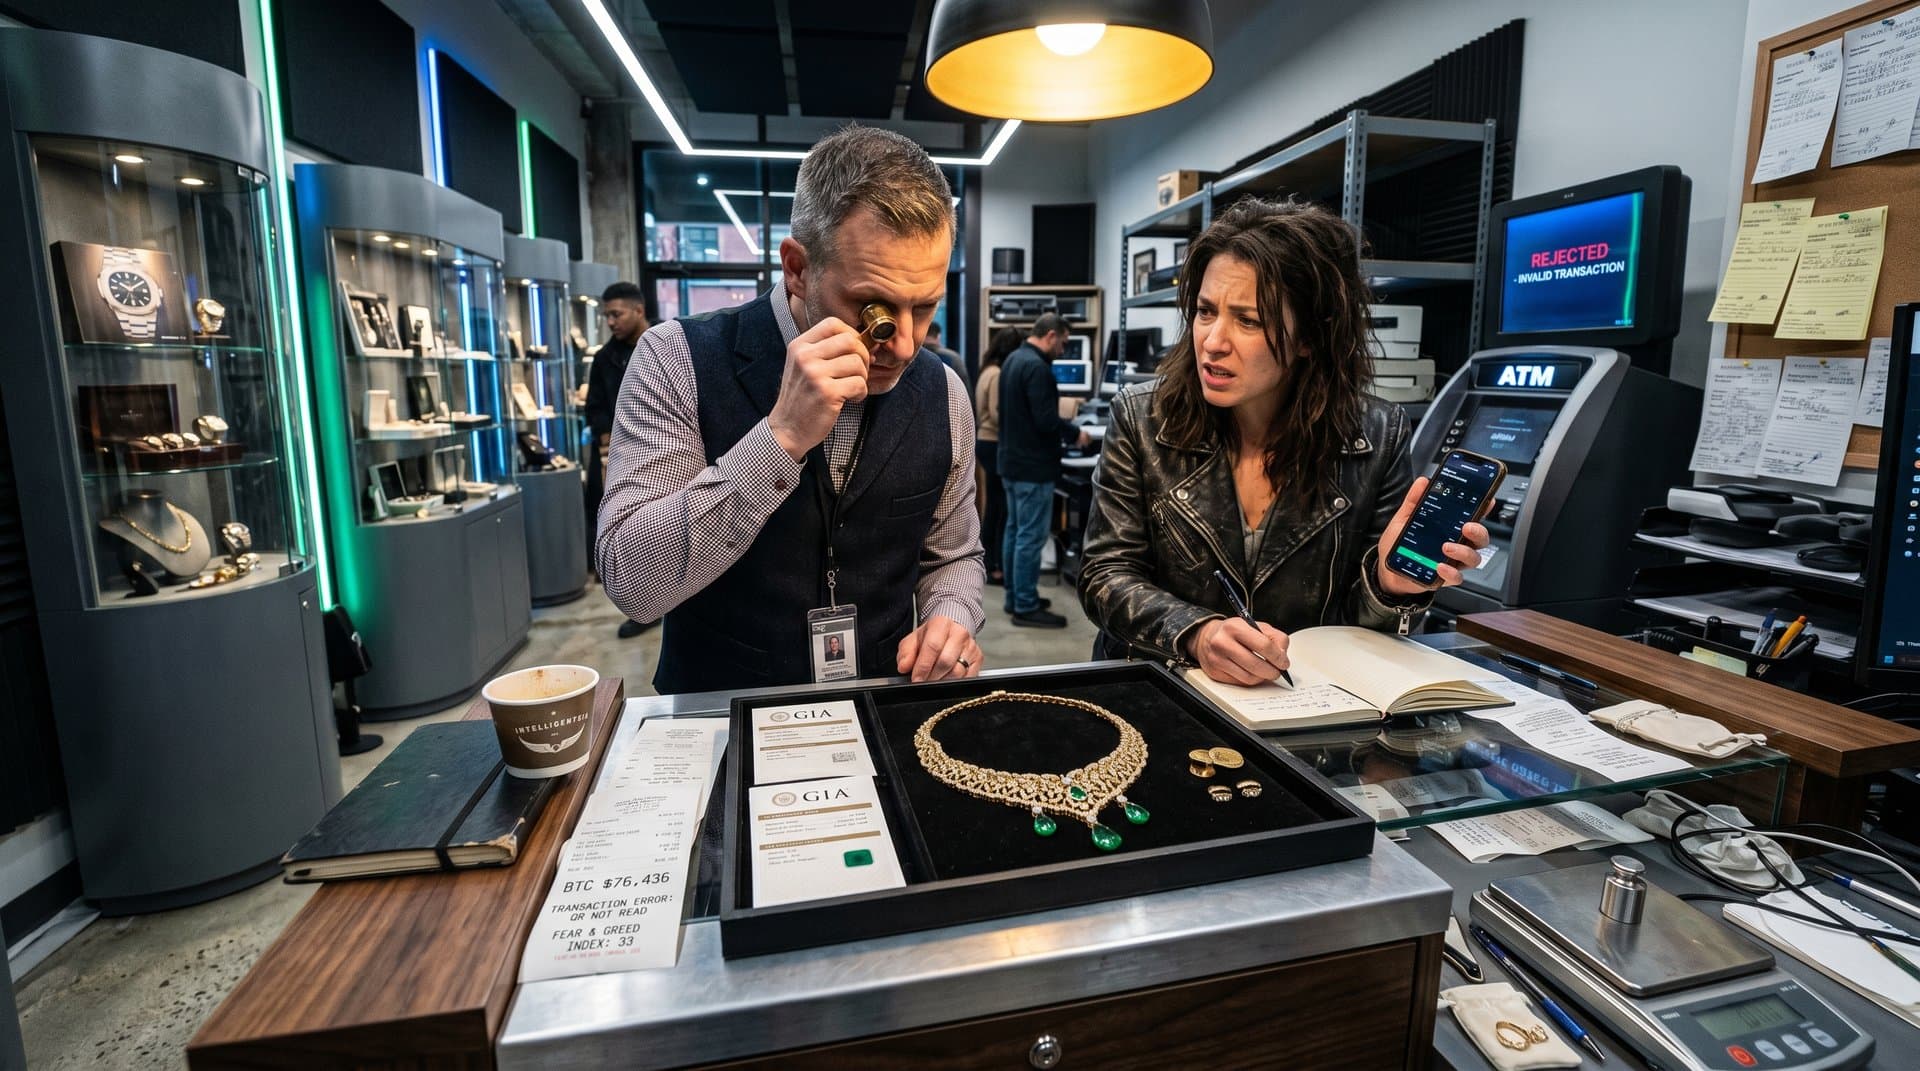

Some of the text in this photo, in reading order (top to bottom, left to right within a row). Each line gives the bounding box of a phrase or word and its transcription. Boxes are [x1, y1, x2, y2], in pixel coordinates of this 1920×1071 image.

[1531, 243, 1609, 268] REJECTED
[1518, 270, 1552, 284] INVALID
[1554, 261, 1625, 280] TRANSACTION
[1497, 365, 1556, 387] ATM
[794, 709, 832, 720] GIA
[802, 788, 849, 802] GIA
[563, 872, 670, 893] BTC $76,436
[551, 894, 673, 914] TRANSACTION ERROR:
[591, 910, 612, 920] NOT
[618, 906, 648, 917] READ
[552, 923, 641, 940] FEAR & GREED
[567, 936, 634, 952] INDEX: 33
